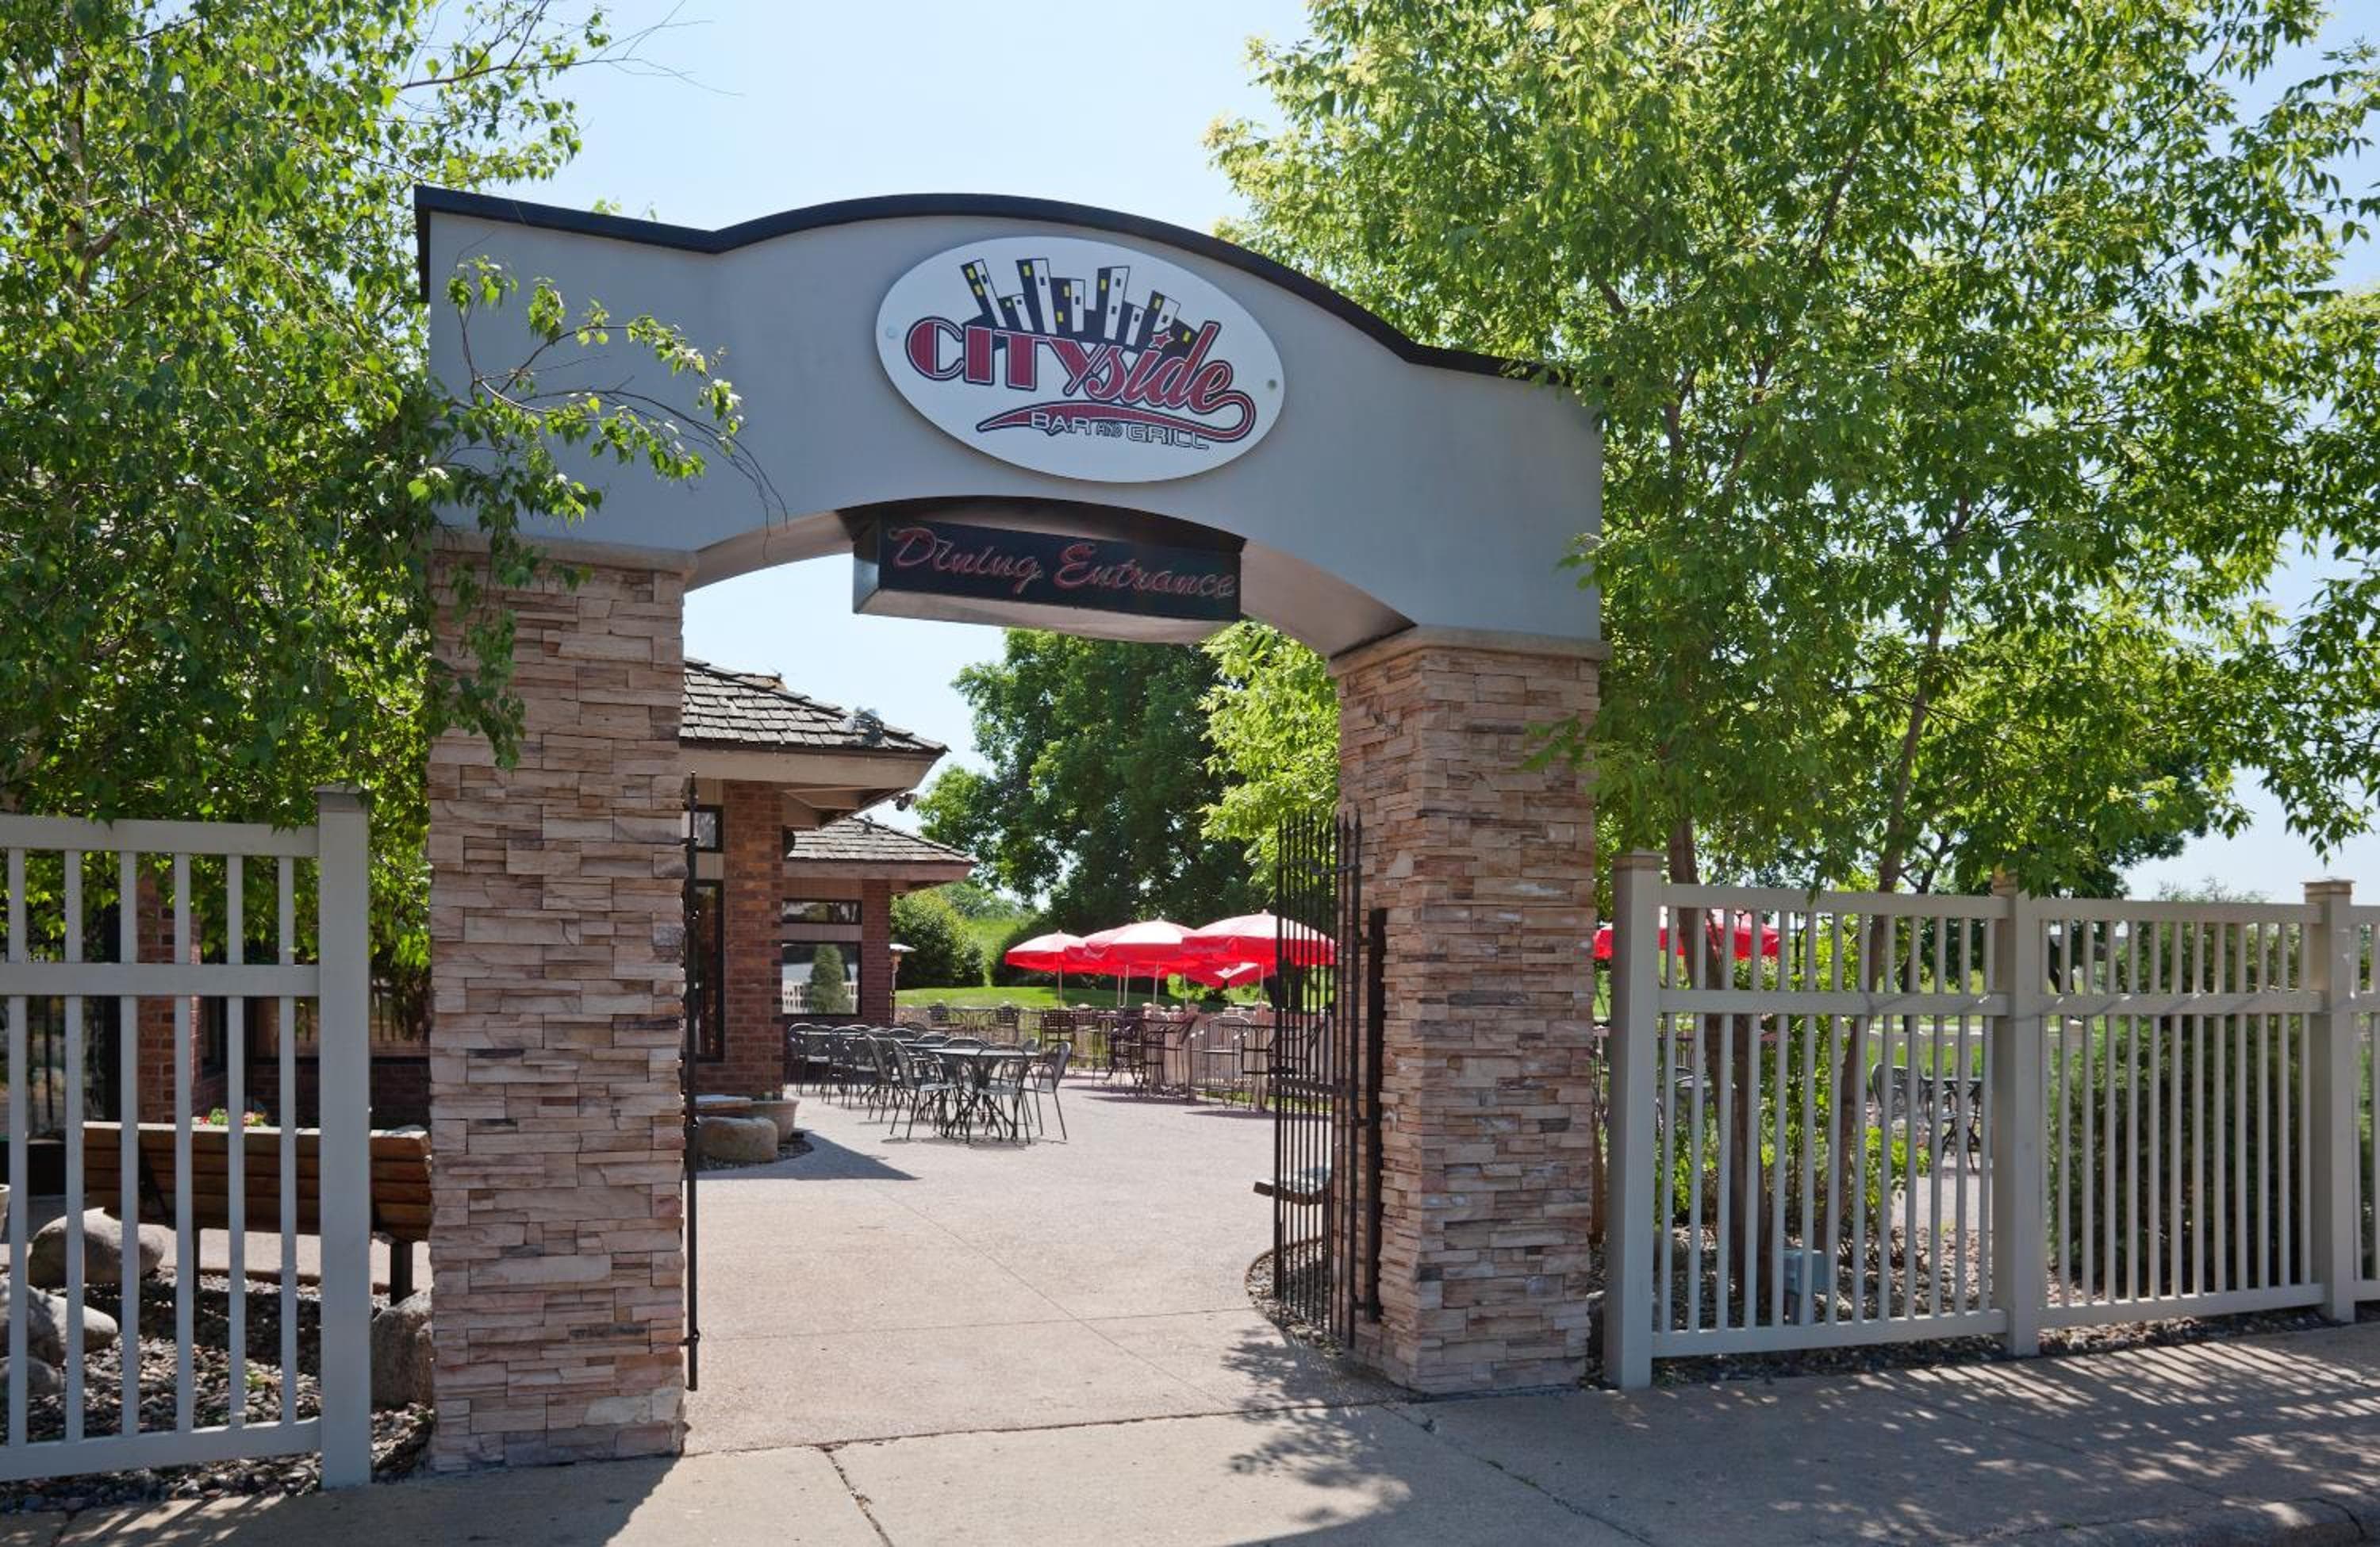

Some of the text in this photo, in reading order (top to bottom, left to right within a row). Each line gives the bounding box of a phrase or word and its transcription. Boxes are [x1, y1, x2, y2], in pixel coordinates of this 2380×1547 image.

[1031, 411, 1210, 450] BAR AND GRILL
[888, 526, 1236, 599] Dining Entrance
